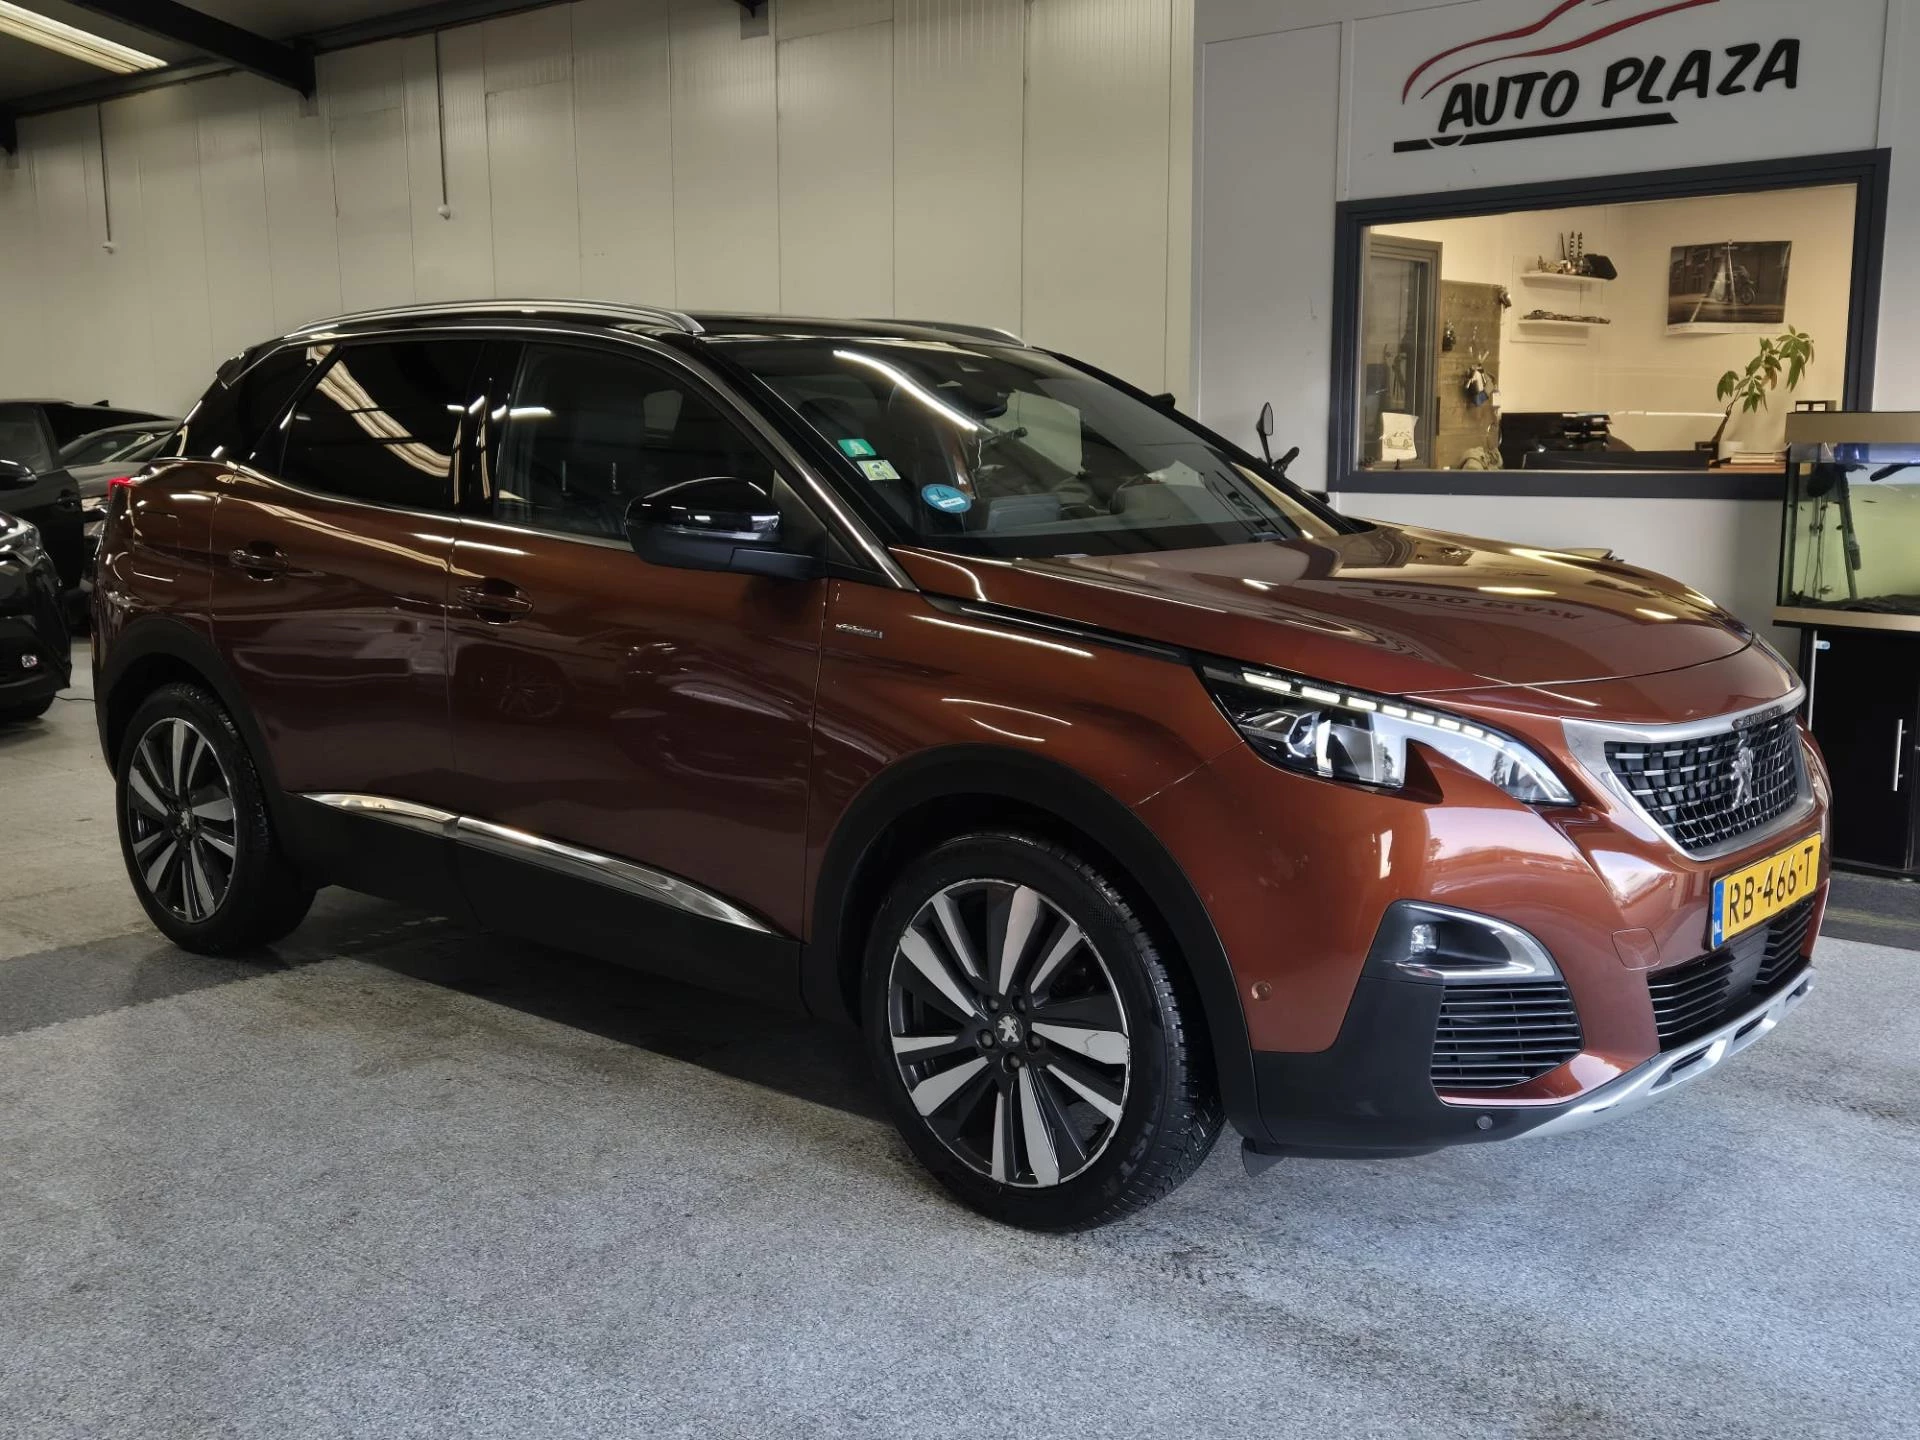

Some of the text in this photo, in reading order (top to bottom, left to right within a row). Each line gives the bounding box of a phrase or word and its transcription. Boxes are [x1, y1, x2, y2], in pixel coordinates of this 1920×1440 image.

[1438, 38, 1800, 133] AUTO PLAZA
[1729, 847, 1813, 927] RB-466-T
